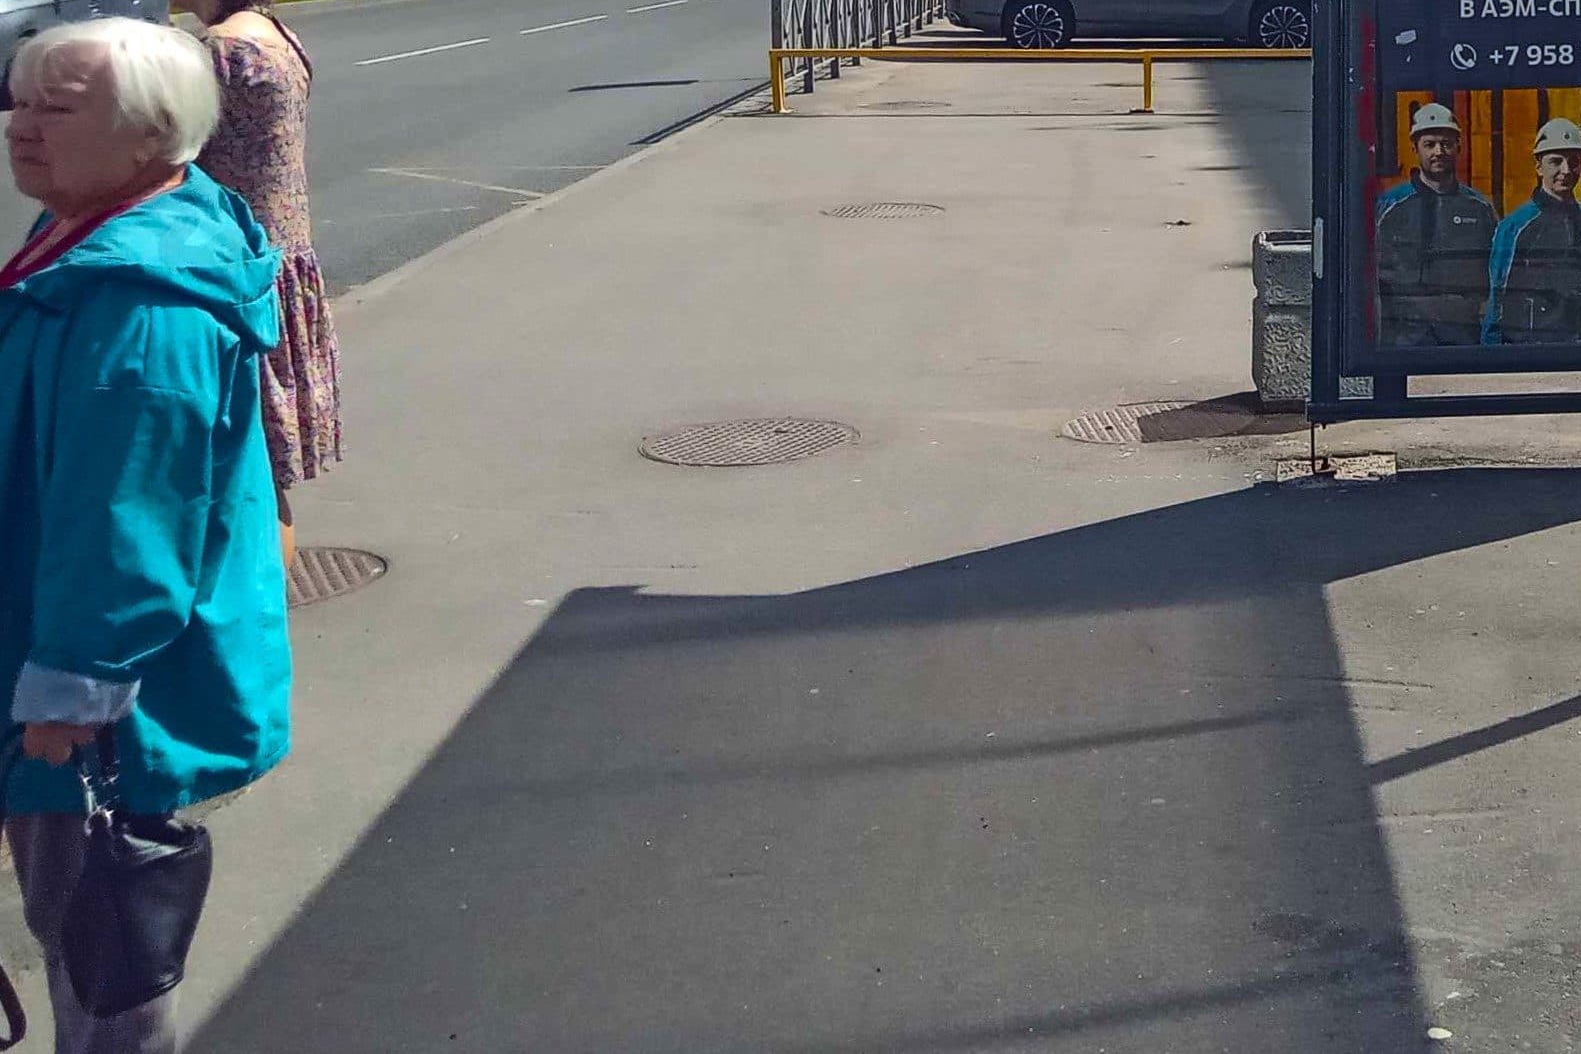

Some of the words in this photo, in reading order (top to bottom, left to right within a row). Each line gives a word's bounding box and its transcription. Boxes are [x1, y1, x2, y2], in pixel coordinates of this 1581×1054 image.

[1461, 0, 1474, 17] В
[1490, 46, 1518, 65] +7
[1527, 45, 1573, 65] 958
